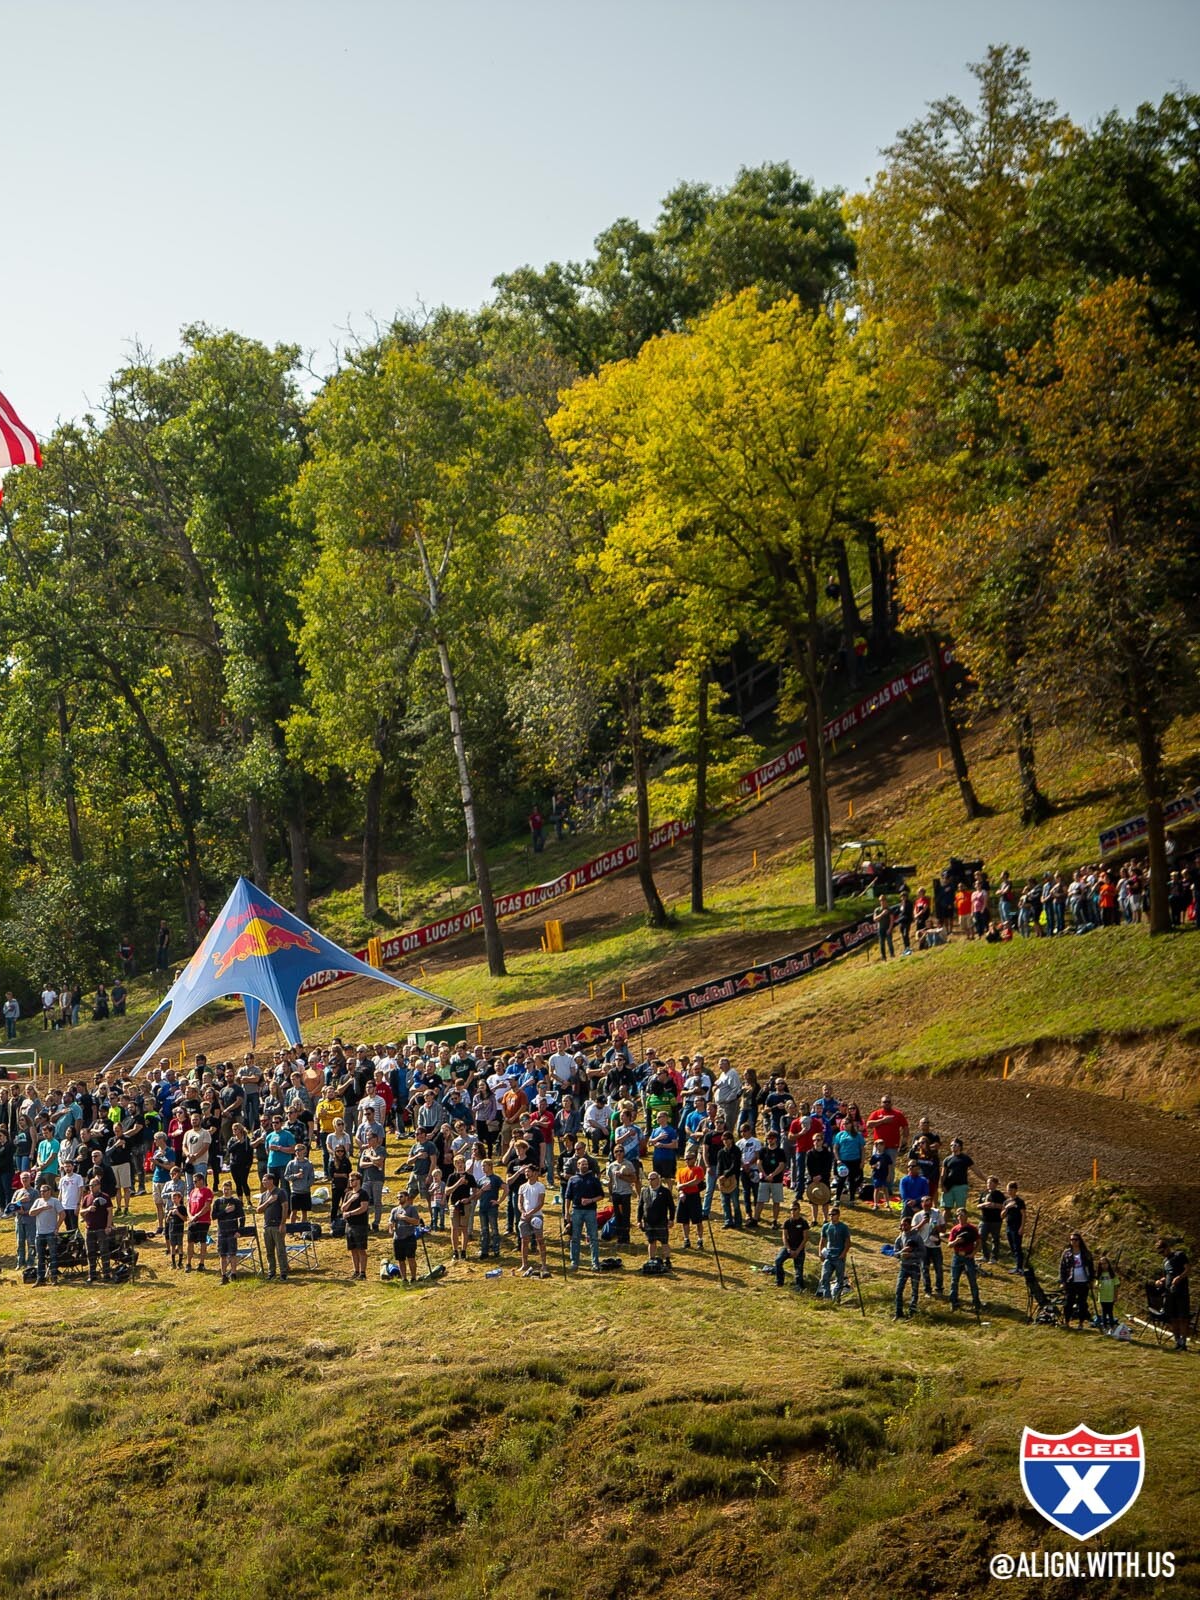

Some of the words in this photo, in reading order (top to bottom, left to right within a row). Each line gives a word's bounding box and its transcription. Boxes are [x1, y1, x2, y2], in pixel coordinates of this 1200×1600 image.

[891, 678, 908, 696] OIL
[754, 757, 787, 786] LUCAS
[788, 746, 805, 765] OIL
[590, 850, 624, 877] LUCAS
[626, 843, 638, 860] OI
[402, 934, 420, 951] OIL
[425, 918, 461, 943] LUCAS
[463, 909, 481, 928] OIL
[302, 970, 339, 990] LUCAS
